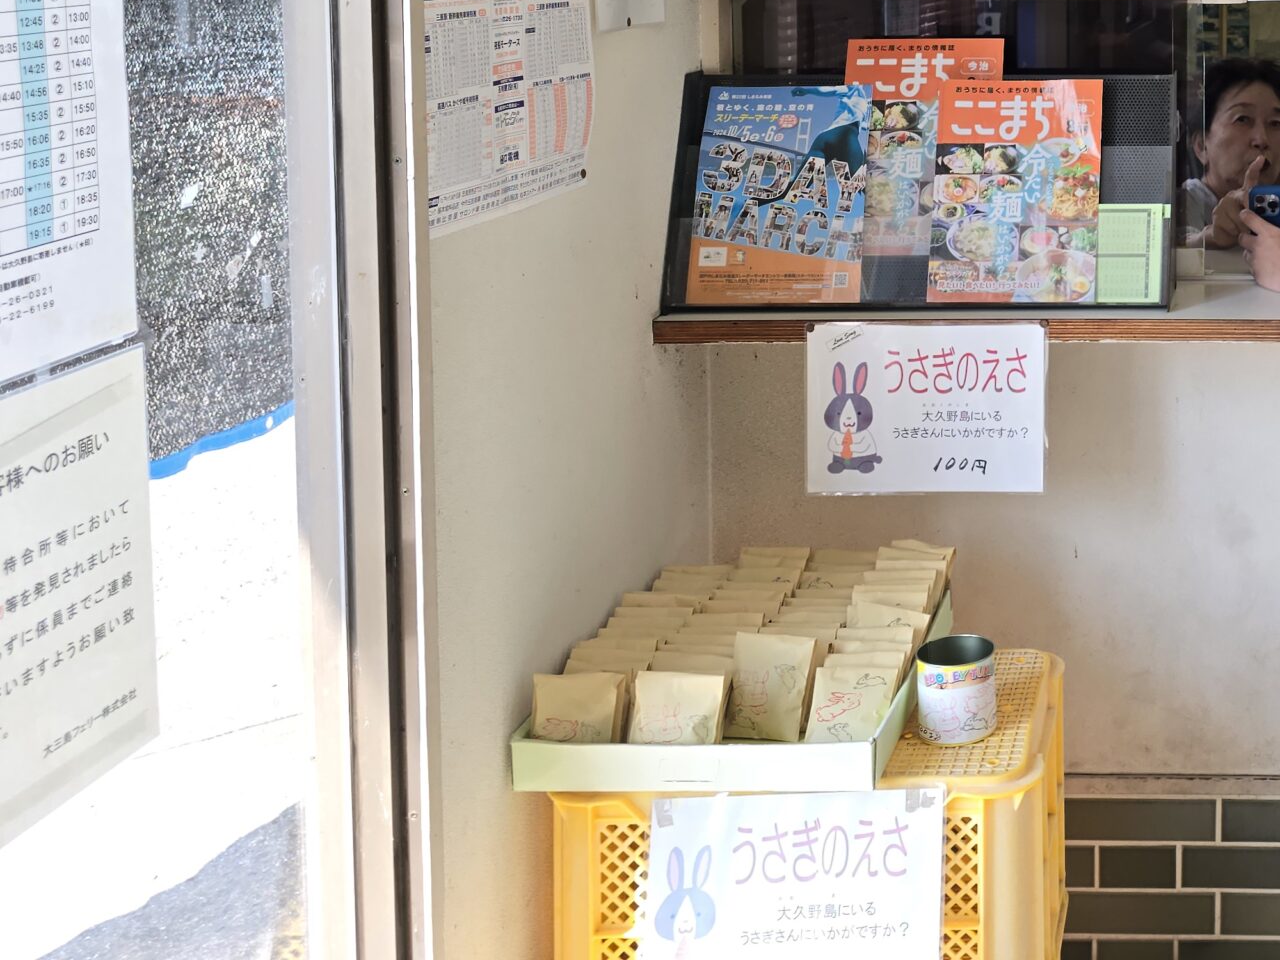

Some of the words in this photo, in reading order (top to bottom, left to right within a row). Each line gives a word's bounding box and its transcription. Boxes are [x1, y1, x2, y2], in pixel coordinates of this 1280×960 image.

[0, 43, 18, 55] 3:35
[967, 60, 989, 72] 今治
[0, 91, 21, 103] 4:40
[951, 95, 1055, 141] ここまち
[884, 347, 1028, 394] うさぎのえさ
[921, 410, 1002, 422] 大久野島にいる
[892, 426, 1029, 439] うさぎさんにいかがですか？
[932, 457, 988, 475] 100円
[732, 816, 910, 886] うさぎのえさ
[777, 901, 877, 922] 大久野島にいる
